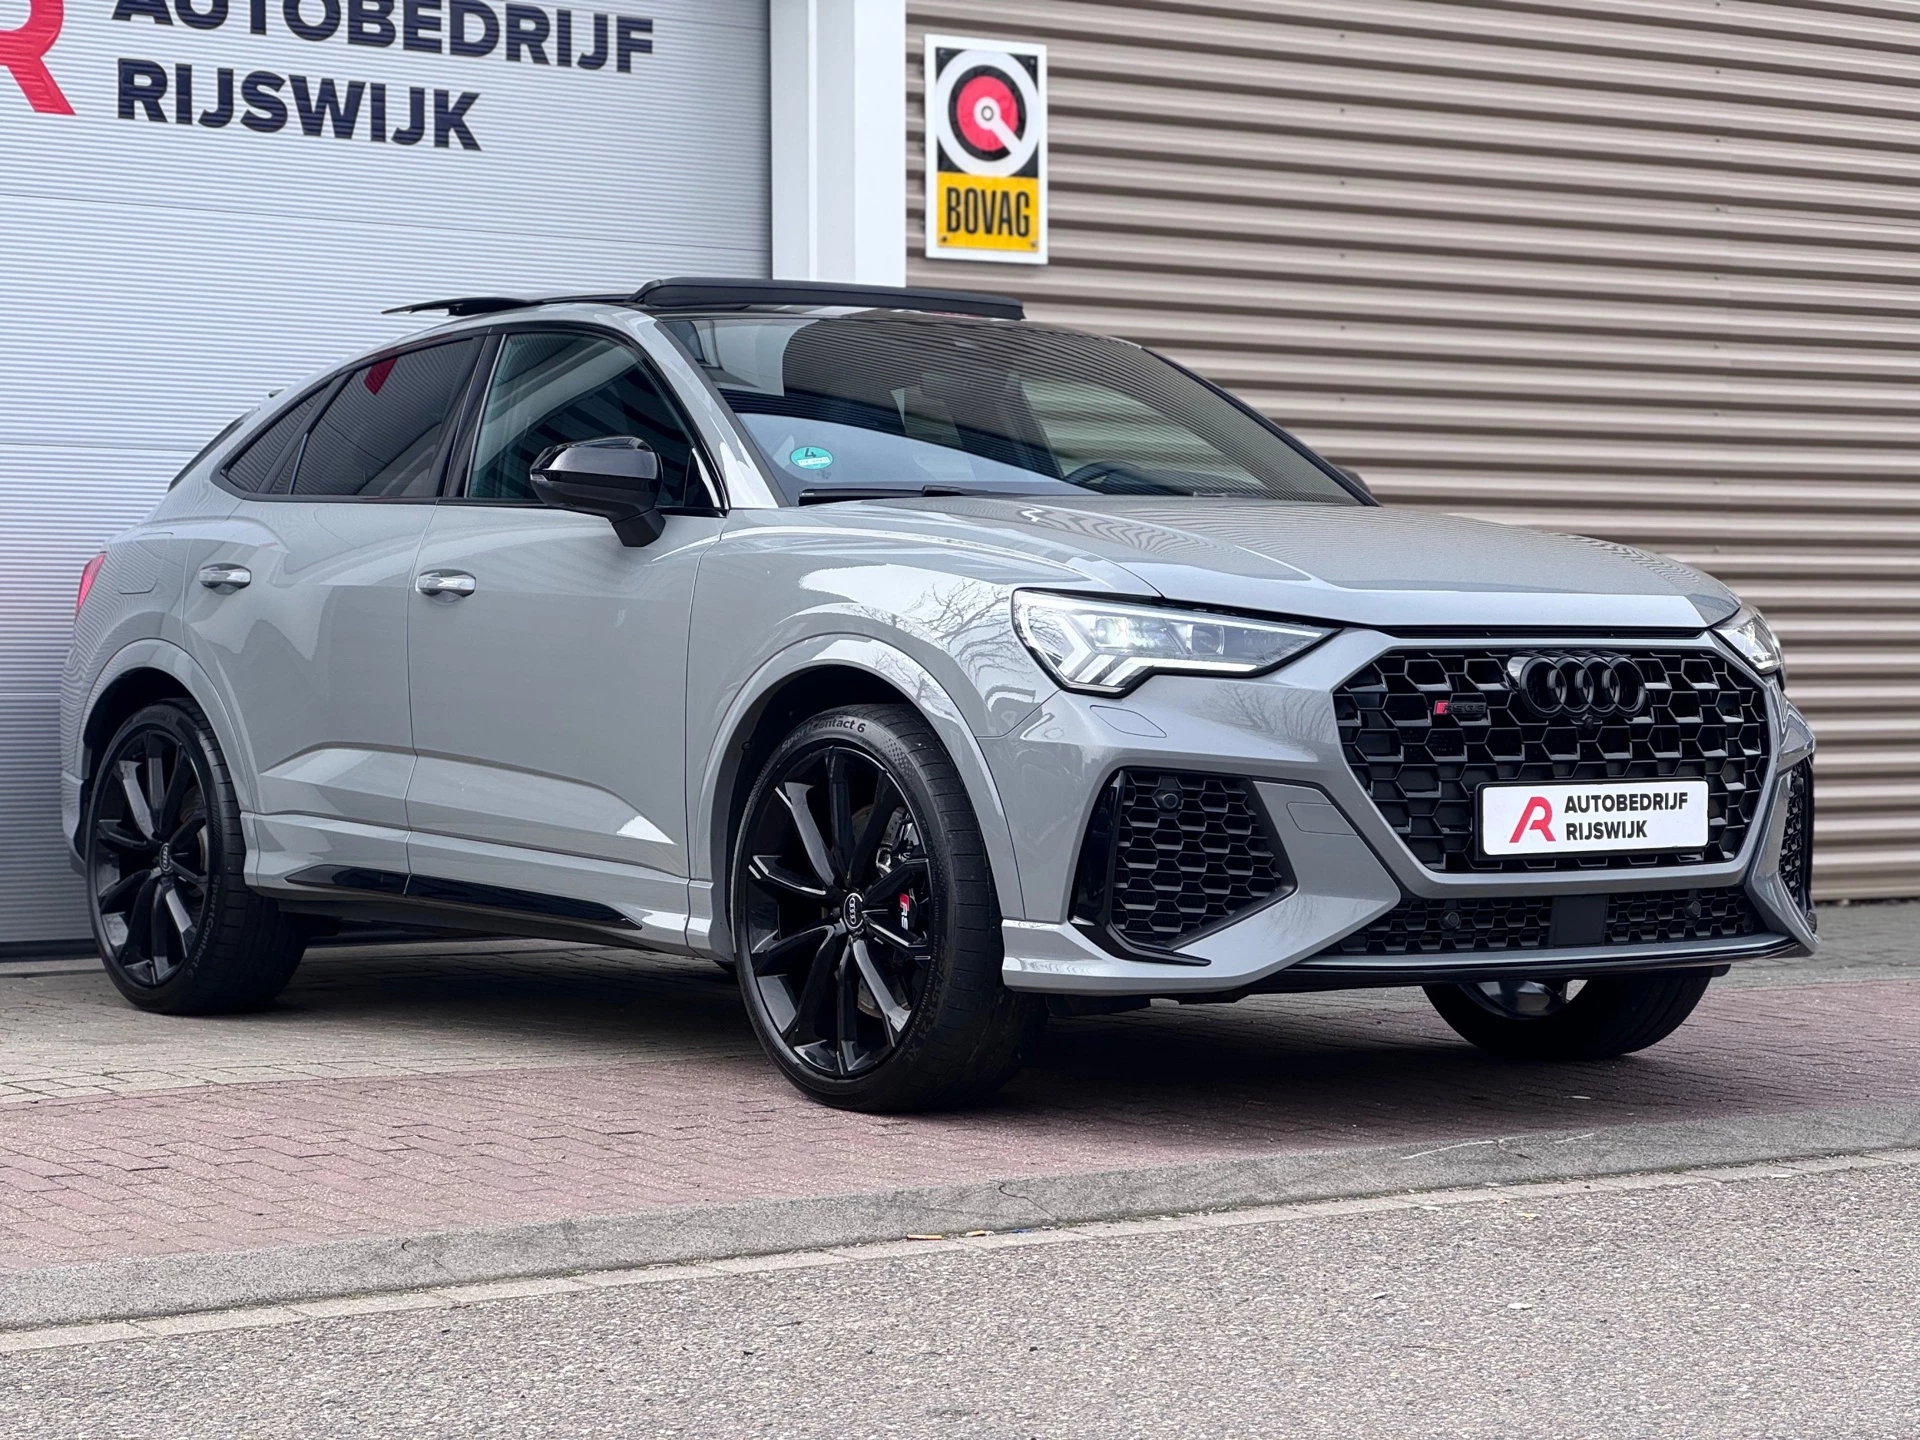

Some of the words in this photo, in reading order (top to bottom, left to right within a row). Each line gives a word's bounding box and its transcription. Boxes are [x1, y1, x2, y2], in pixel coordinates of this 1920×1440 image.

[117, 57, 482, 152] RIJSWIJK
[946, 186, 1030, 237] BOVAG
[804, 447, 817, 458] 4
[857, 722, 866, 733] 6
[1564, 792, 1688, 813] AUTOBEDRIJF
[1565, 820, 1648, 841] RIJSWIJK
